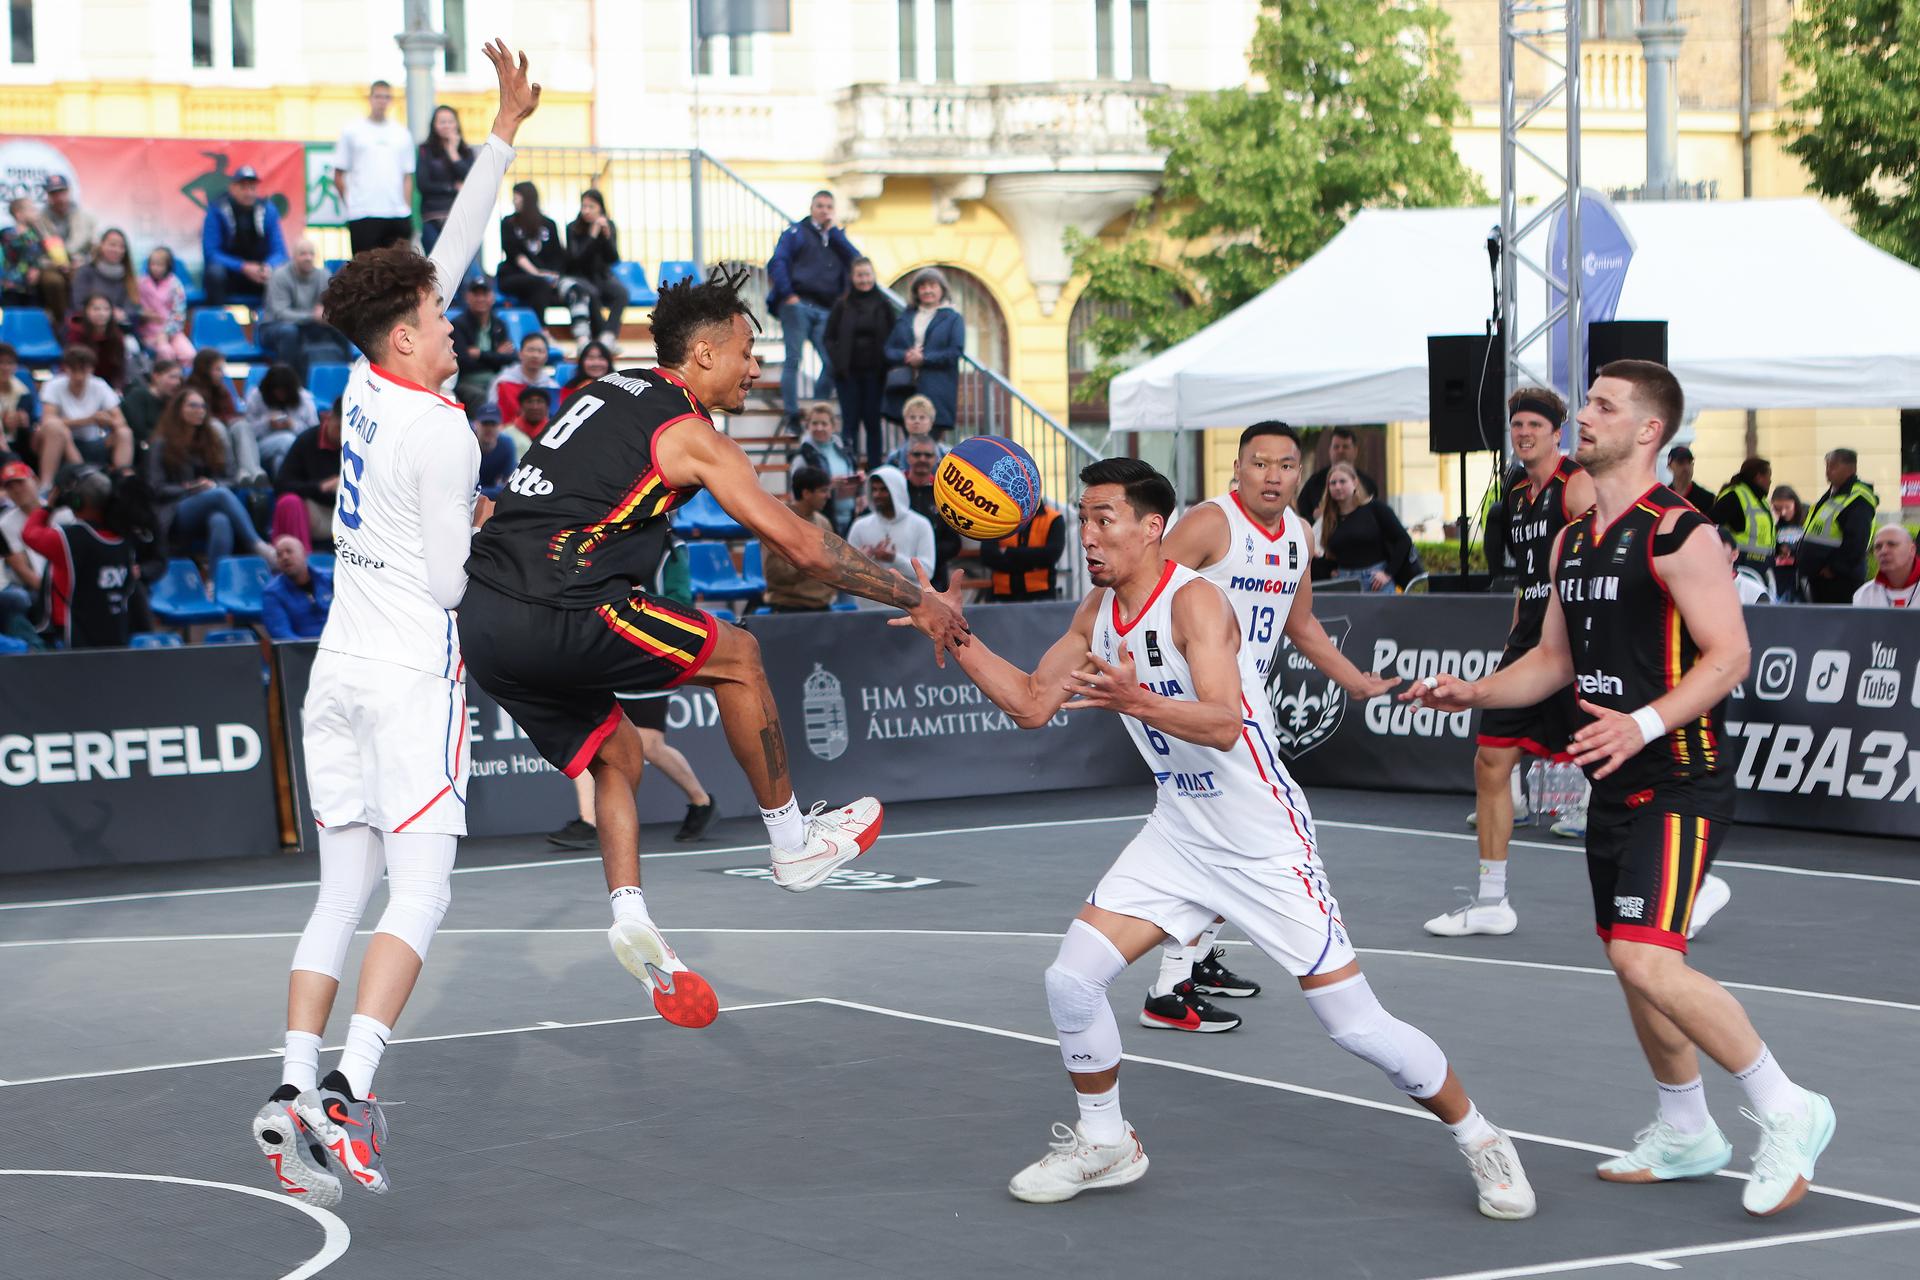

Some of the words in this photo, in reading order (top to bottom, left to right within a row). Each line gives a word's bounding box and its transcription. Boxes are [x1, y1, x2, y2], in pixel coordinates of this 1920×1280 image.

[540, 395, 605, 450] 8
[338, 440, 364, 530] 5
[943, 462, 999, 516] Wilson
[1526, 548, 1535, 574] 2
[1248, 605, 1275, 643] 13
[1871, 642, 1897, 669] You
[1577, 669, 1623, 696] relan
[1863, 675, 1896, 701] Tube
[861, 686, 907, 711] HM
[1172, 771, 1214, 791] MIAT
